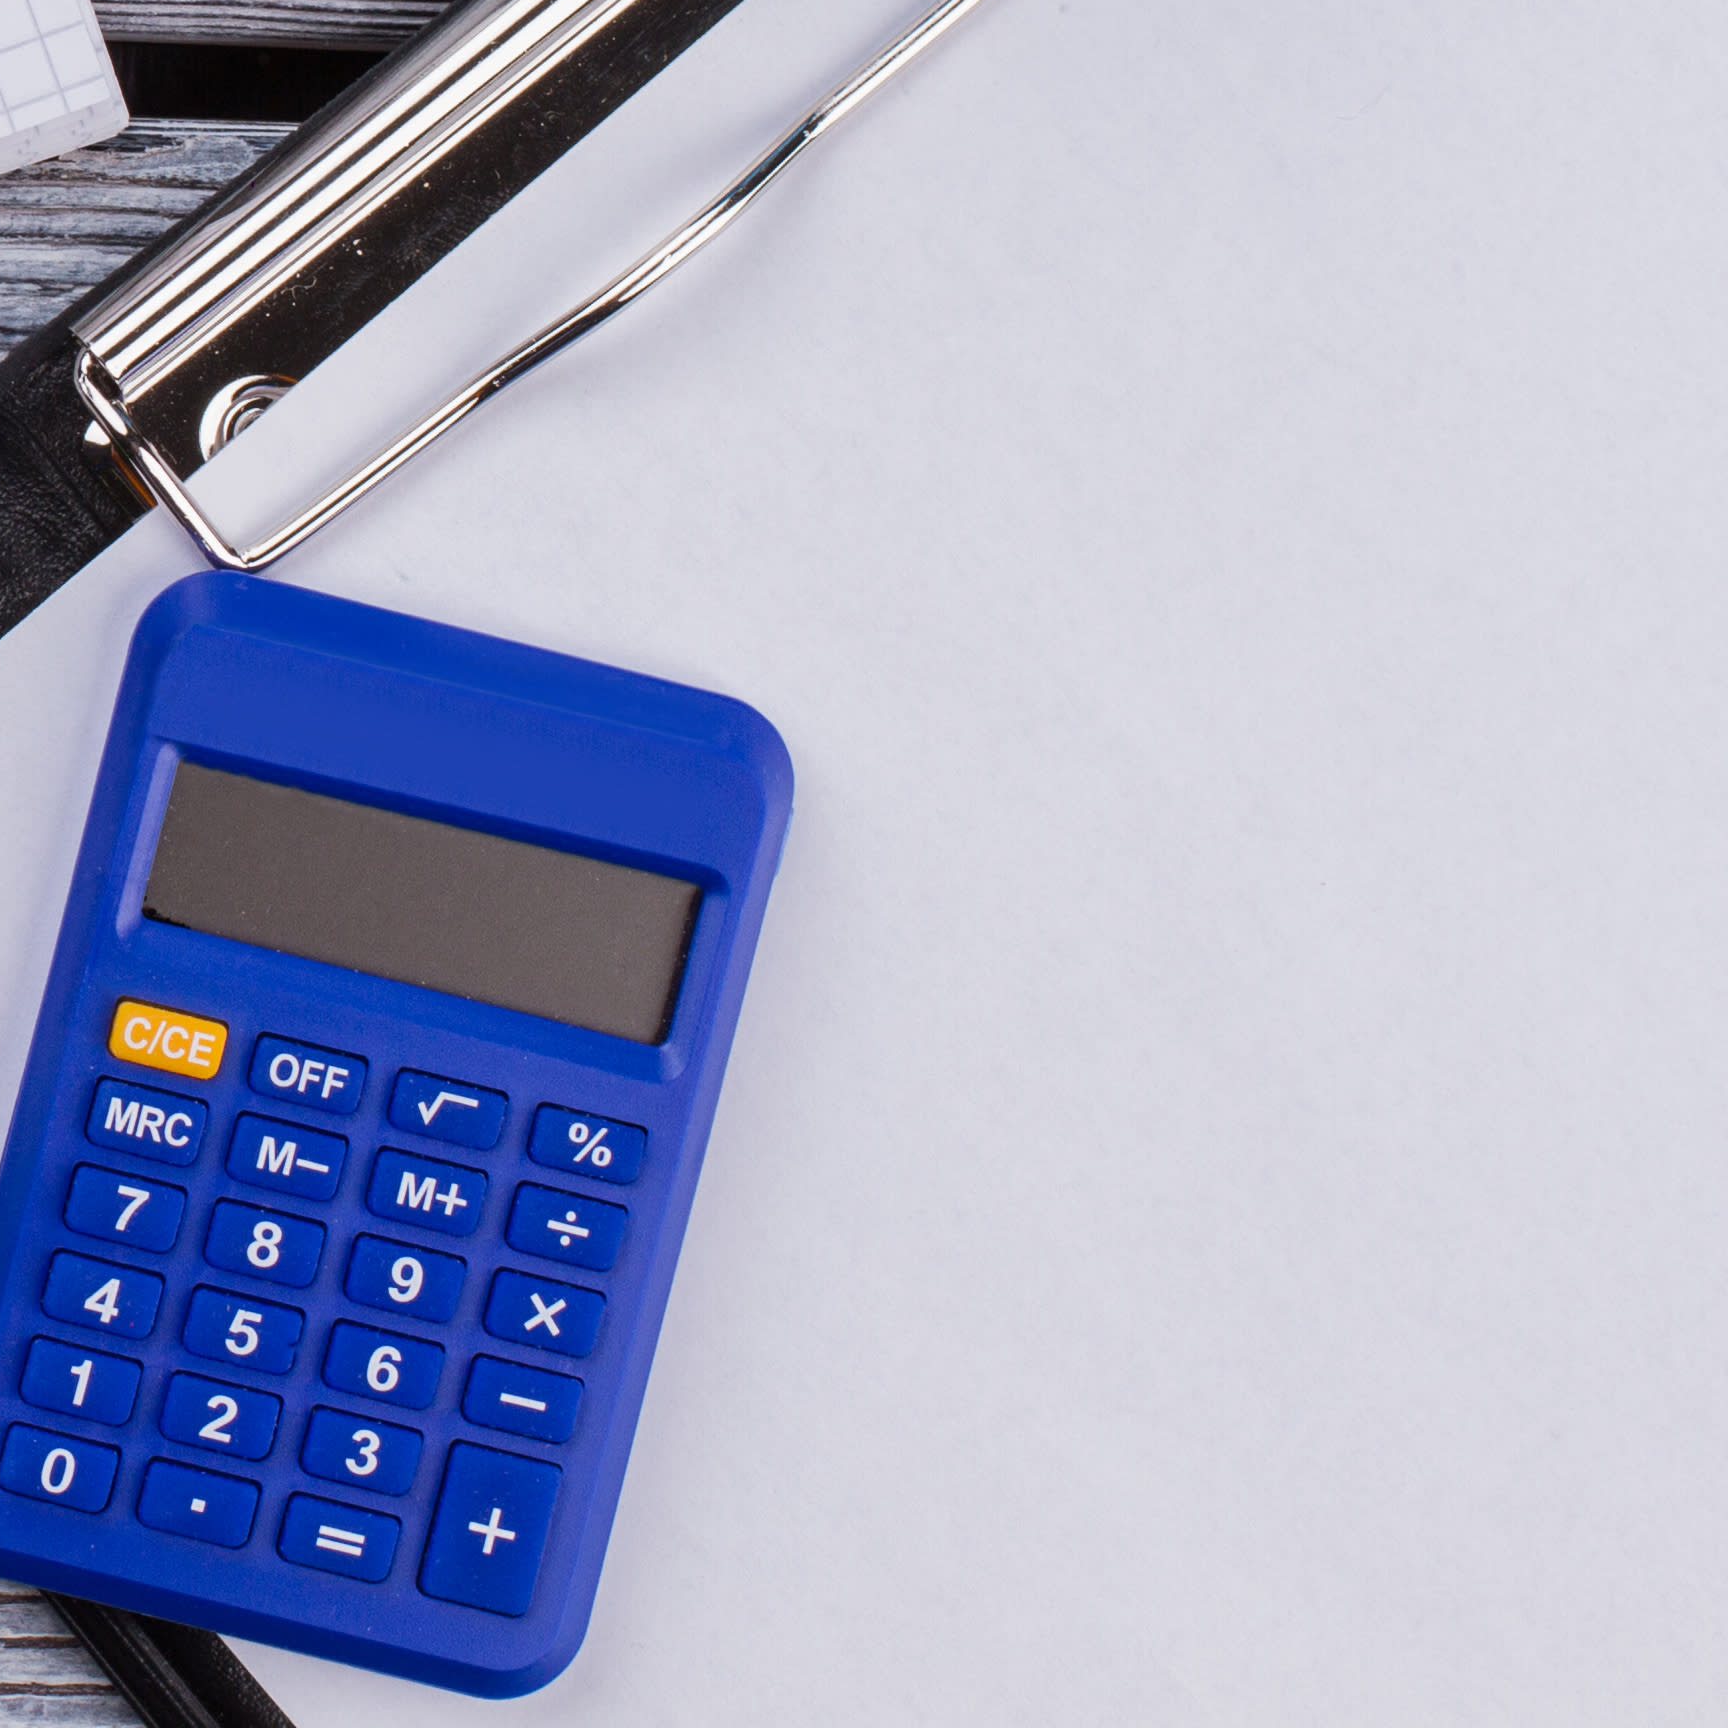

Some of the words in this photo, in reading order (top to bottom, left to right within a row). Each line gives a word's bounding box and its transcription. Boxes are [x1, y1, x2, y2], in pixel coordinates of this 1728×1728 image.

[122, 1015, 217, 1067] C/CE
[269, 1053, 349, 1099] OFF
[104, 1096, 193, 1147] MRC
[568, 1122, 612, 1167] %
[115, 1184, 150, 1231] 7
[396, 1177, 468, 1217] M+
[246, 1221, 283, 1268] 8
[83, 1278, 121, 1324] 4
[388, 1256, 424, 1303] 9
[225, 1308, 262, 1356] 5
[70, 1359, 93, 1406] 1
[366, 1345, 402, 1392] 6
[198, 1394, 238, 1443] 2
[40, 1447, 76, 1494] 0
[345, 1429, 381, 1476] 3
[468, 1507, 516, 1555] +
